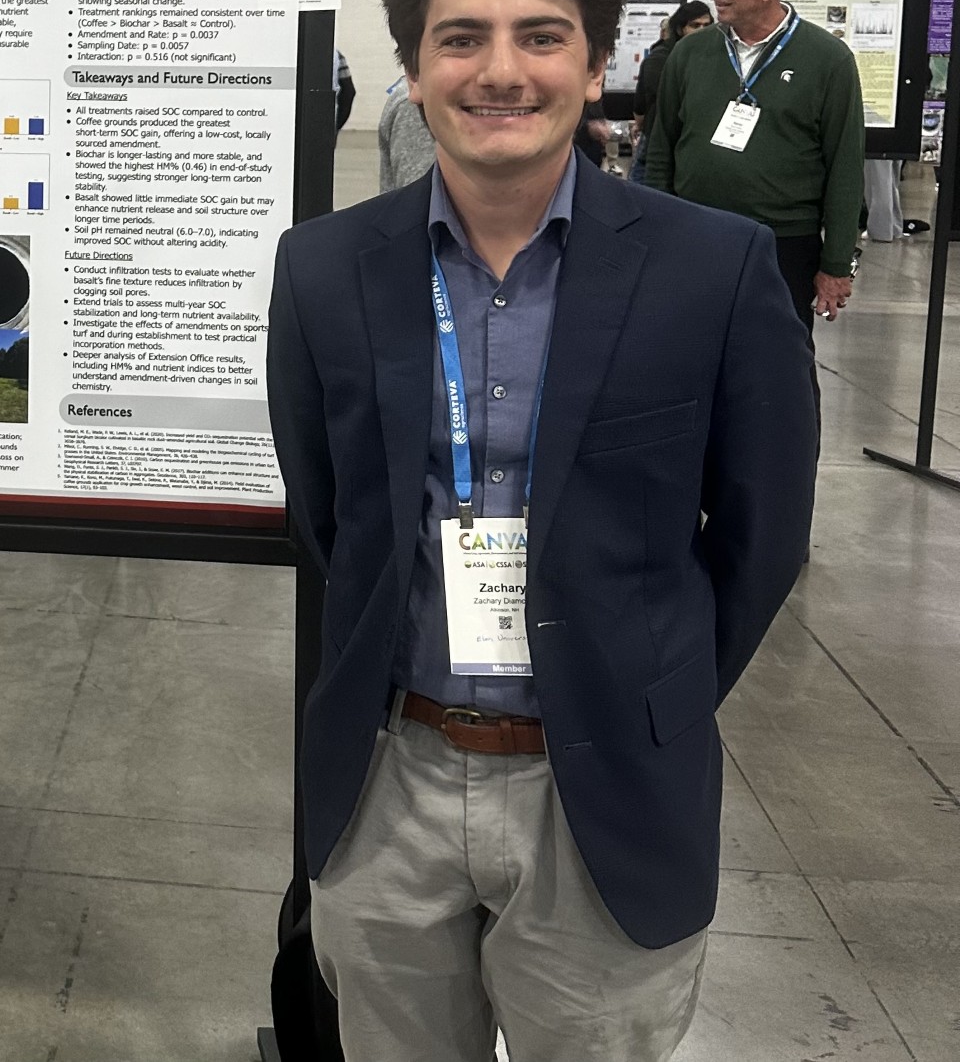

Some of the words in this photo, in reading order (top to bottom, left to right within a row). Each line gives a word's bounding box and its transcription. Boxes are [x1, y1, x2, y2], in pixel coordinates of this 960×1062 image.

[77, 30, 127, 39] Amendment
[130, 30, 146, 39] and
[148, 31, 169, 39] Rate:
[172, 32, 178, 41] p
[190, 31, 219, 40] 0.0037
[72, 71, 134, 87] Takeaways
[138, 72, 159, 84] and
[164, 72, 204, 84] Future
[208, 72, 272, 85] Directions
[67, 92, 82, 101] Key
[84, 92, 128, 102] Takeaways
[65, 250, 91, 261] Future
[93, 251, 133, 262] Directions
[431, 275, 446, 318] CORTEVA
[449, 379, 461, 429] CORTEVA
[67, 404, 133, 418] References
[472, 560, 485, 568] ASA
[479, 583, 527, 595] Zachary
[473, 597, 501, 605] Zachary
[492, 664, 527, 673] Member
